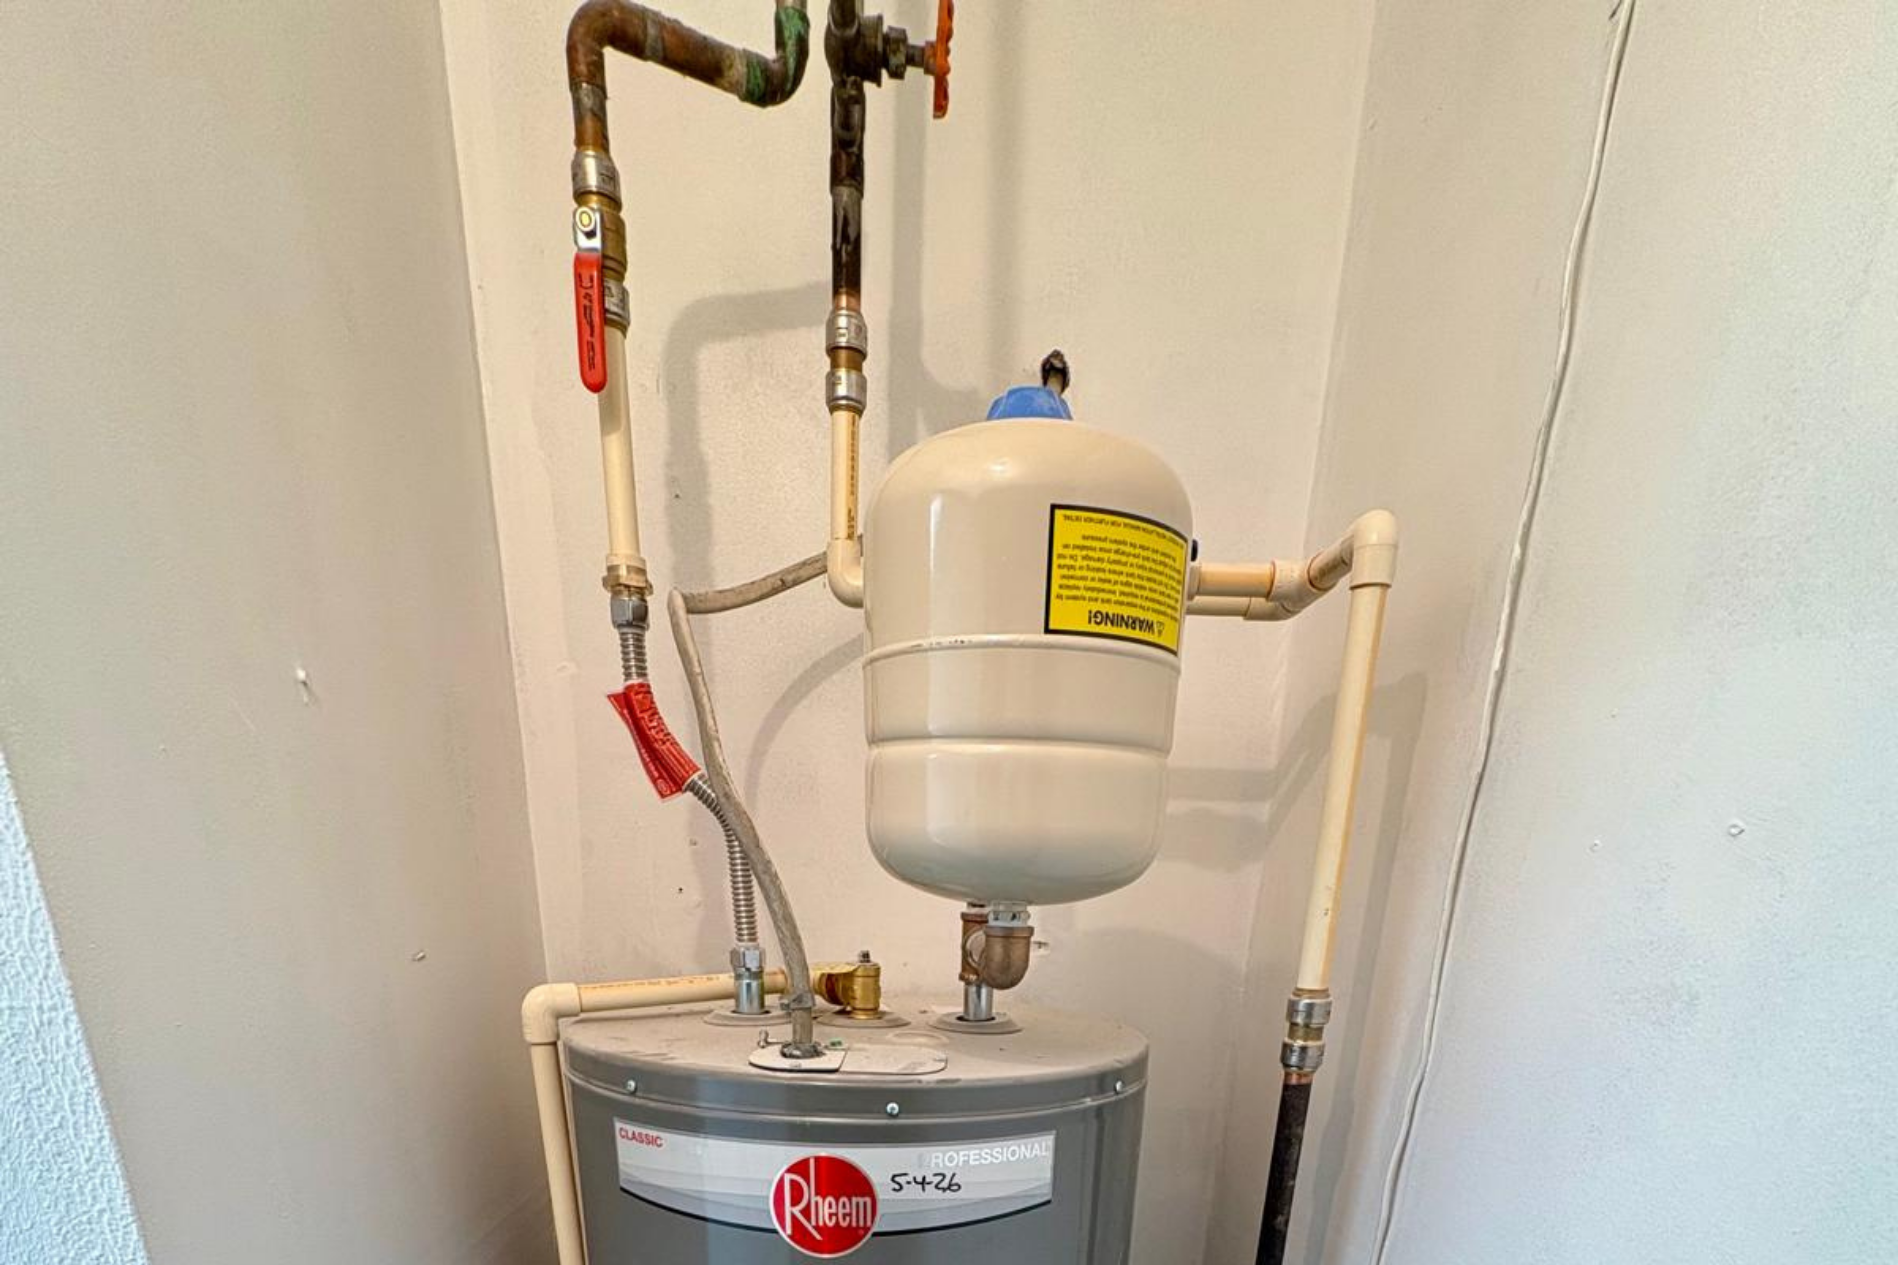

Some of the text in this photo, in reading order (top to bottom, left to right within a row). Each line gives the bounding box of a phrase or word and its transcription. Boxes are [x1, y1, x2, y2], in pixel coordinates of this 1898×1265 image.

[1088, 610, 1154, 633] WARNING!
[618, 1127, 664, 1148] CLASSIC
[782, 1157, 873, 1240] Rheem
